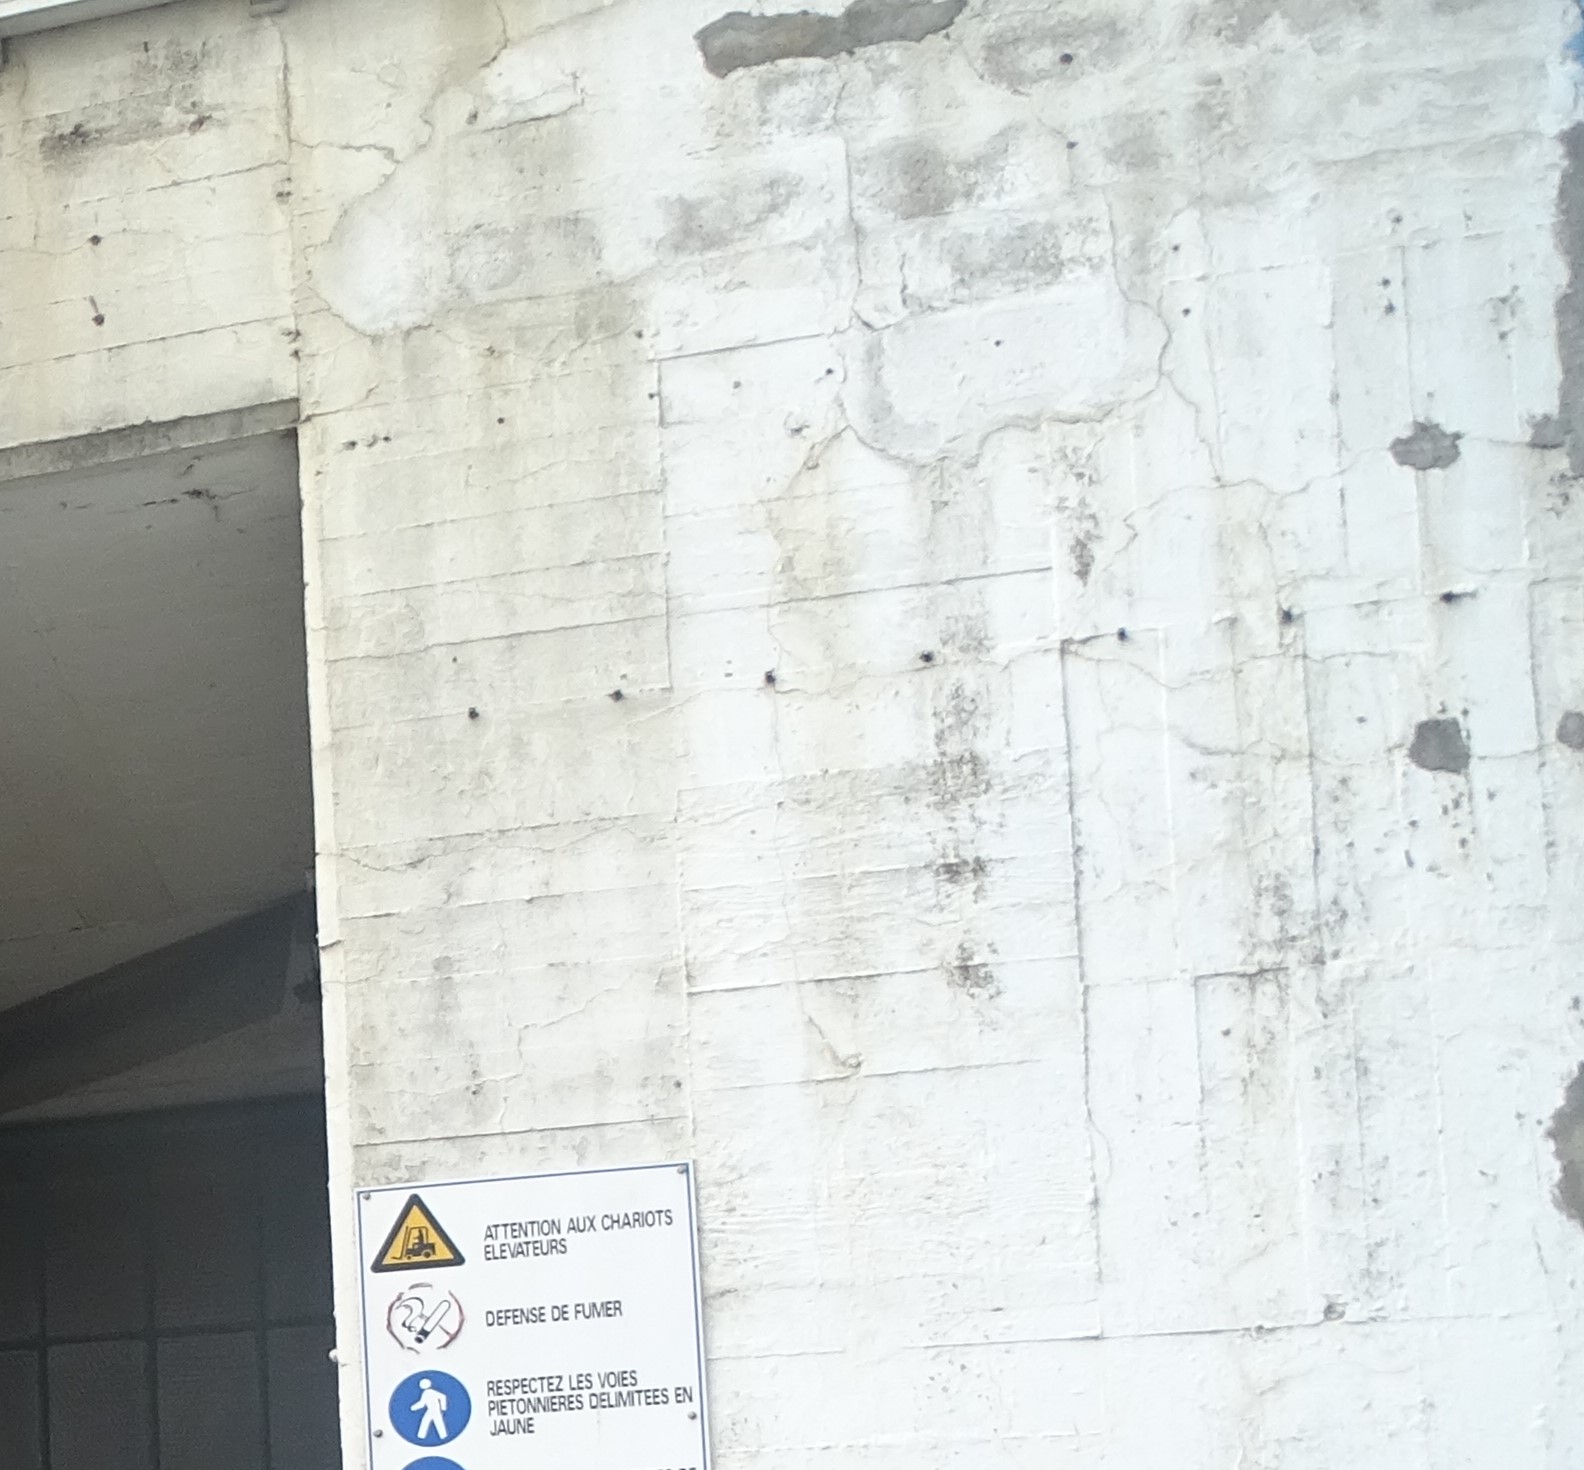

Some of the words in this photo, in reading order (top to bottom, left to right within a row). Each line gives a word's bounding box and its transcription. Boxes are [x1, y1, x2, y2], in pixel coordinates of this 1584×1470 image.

[484, 1219, 561, 1241] ATTENTION
[567, 1215, 596, 1234] AUX
[601, 1209, 673, 1231] CHARIOTS
[484, 1238, 567, 1261] ELEVATEURS
[486, 1306, 546, 1327] DEFENSE
[551, 1304, 569, 1322] DE
[574, 1300, 623, 1320] FUMER
[486, 1375, 564, 1396] RESPECTEZ
[569, 1373, 593, 1391] LES
[598, 1370, 638, 1388] VOIES
[488, 1394, 584, 1416] PIETONNIERES
[589, 1388, 669, 1409] DELIMITEES
[674, 1386, 693, 1403] EN
[490, 1417, 534, 1436] JAUNE
